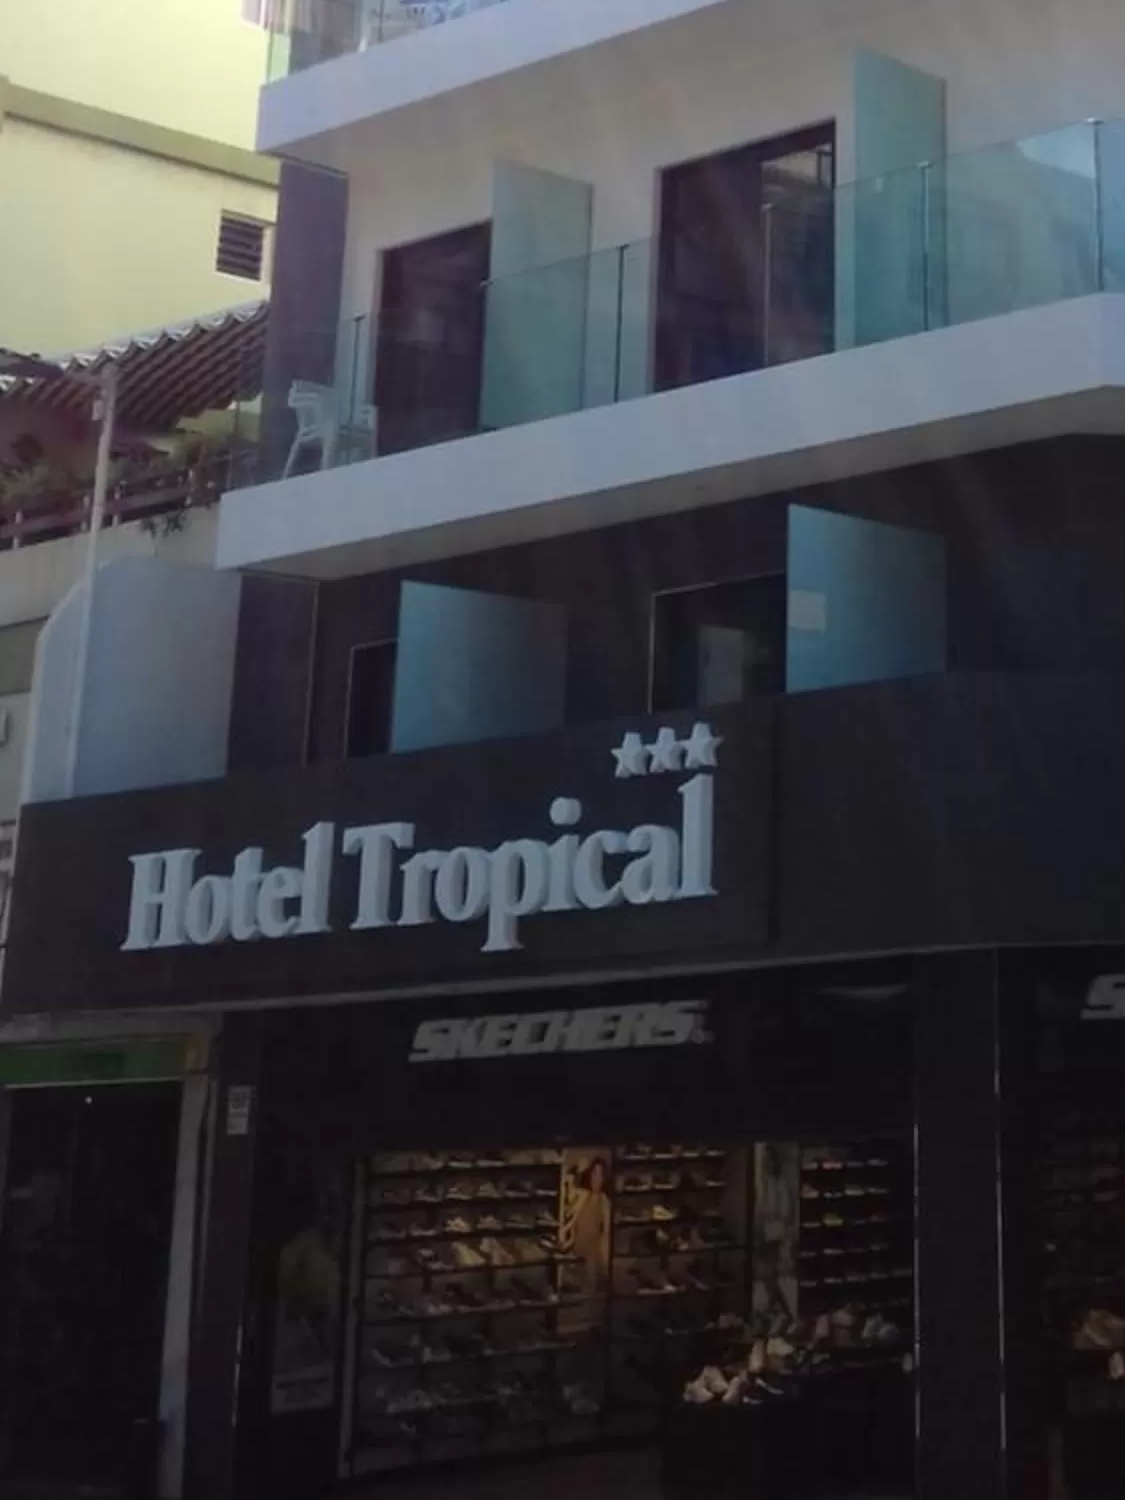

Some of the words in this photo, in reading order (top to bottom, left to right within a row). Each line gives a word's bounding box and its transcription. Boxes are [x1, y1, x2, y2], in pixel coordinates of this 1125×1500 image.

[119, 820, 335, 952] Hotel
[342, 773, 718, 952] Tropical
[408, 999, 709, 1063] SKECHERS
